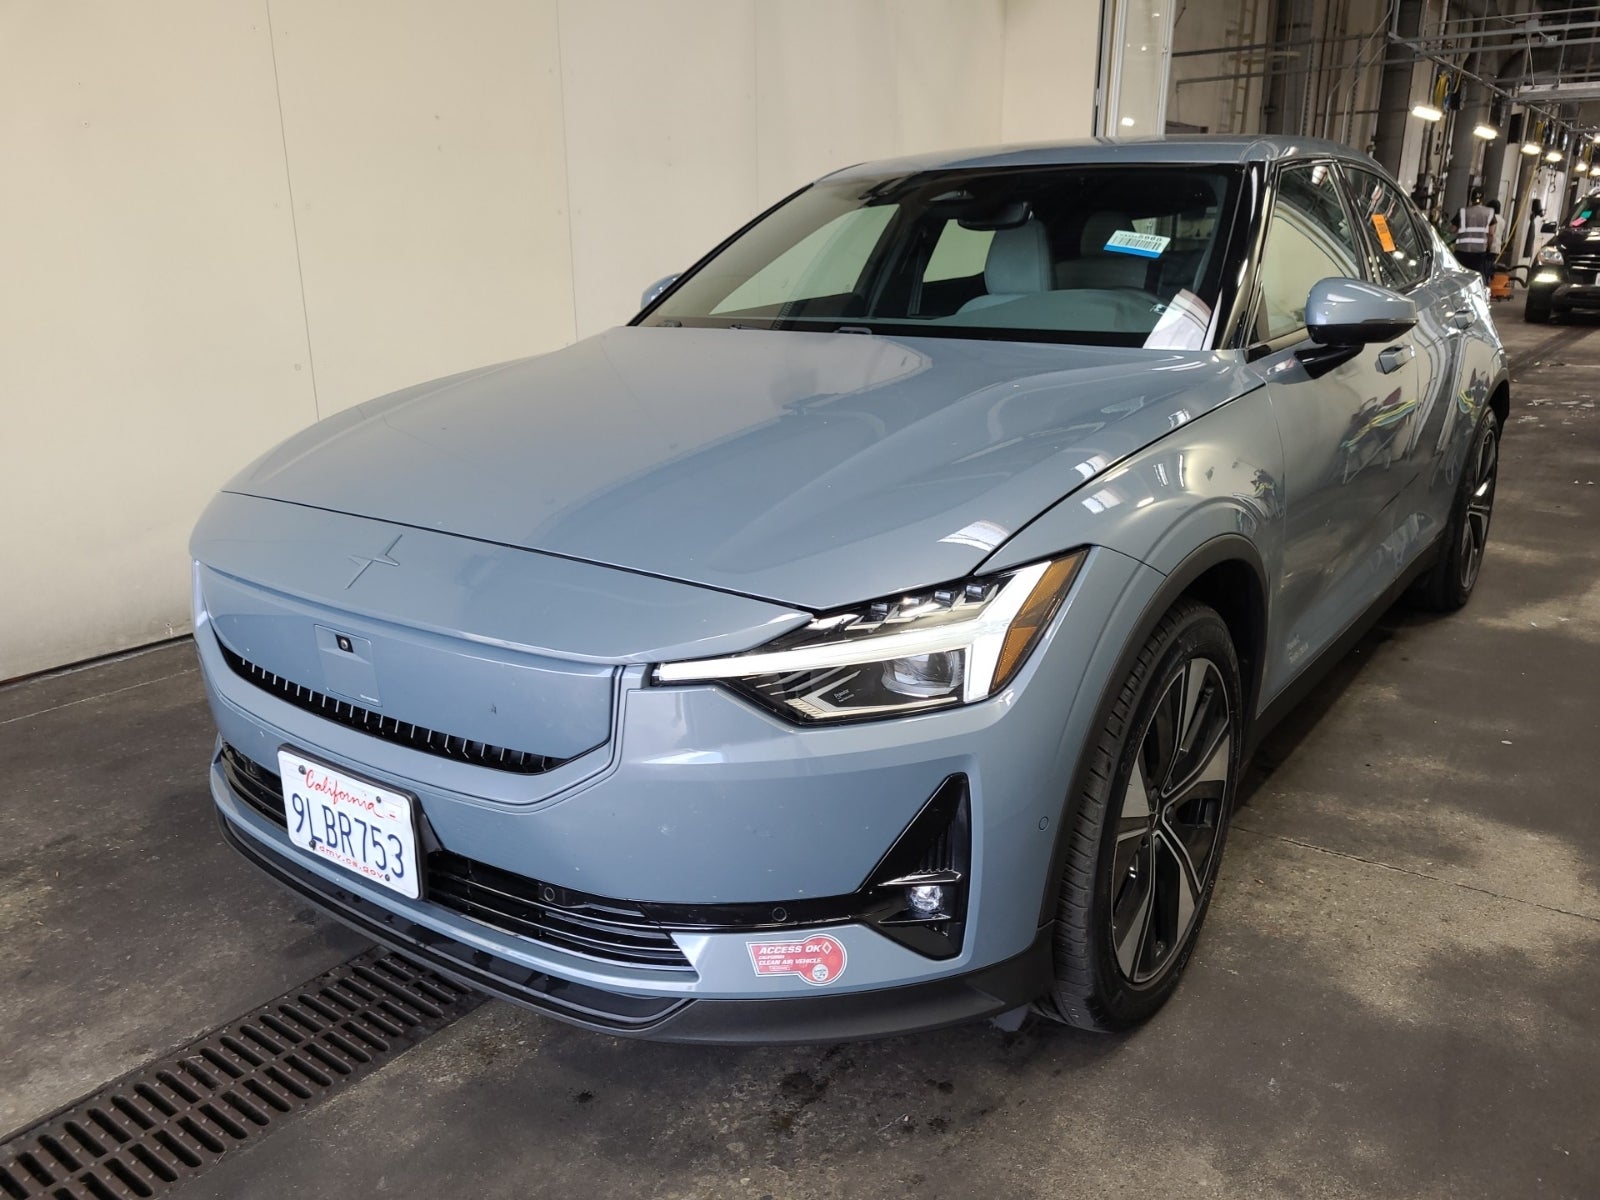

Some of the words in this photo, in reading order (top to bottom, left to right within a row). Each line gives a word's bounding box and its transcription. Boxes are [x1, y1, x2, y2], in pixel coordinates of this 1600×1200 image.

[305, 769, 384, 818] California
[292, 793, 404, 879] 9LBR753
[758, 945, 802, 955] ACCESS
[805, 944, 822, 953] OK
[795, 957, 822, 965] VEHICLE
